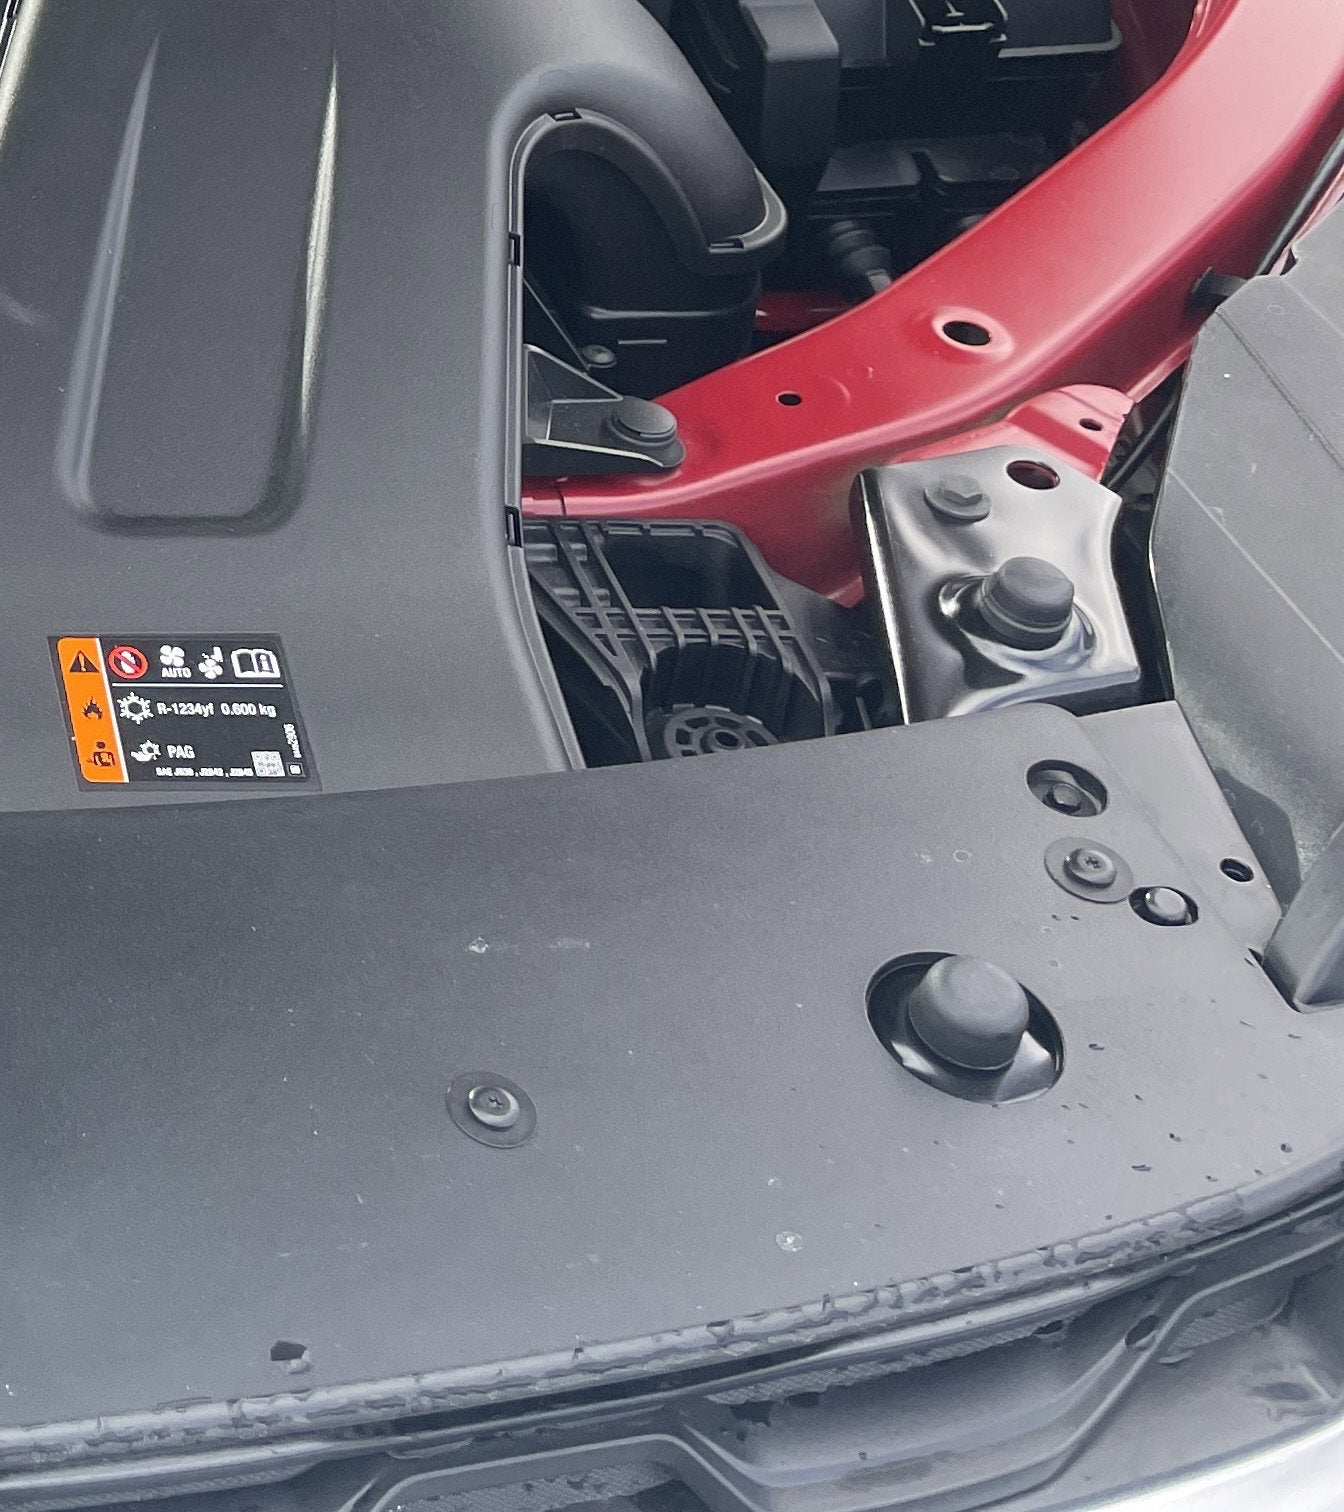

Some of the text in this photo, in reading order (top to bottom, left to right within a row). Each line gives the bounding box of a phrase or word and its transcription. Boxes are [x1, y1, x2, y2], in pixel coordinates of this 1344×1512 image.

[161, 667, 192, 678] AUTO
[156, 702, 214, 718] R-1234yf
[259, 702, 277, 718] kg
[166, 744, 196, 759] PAG
